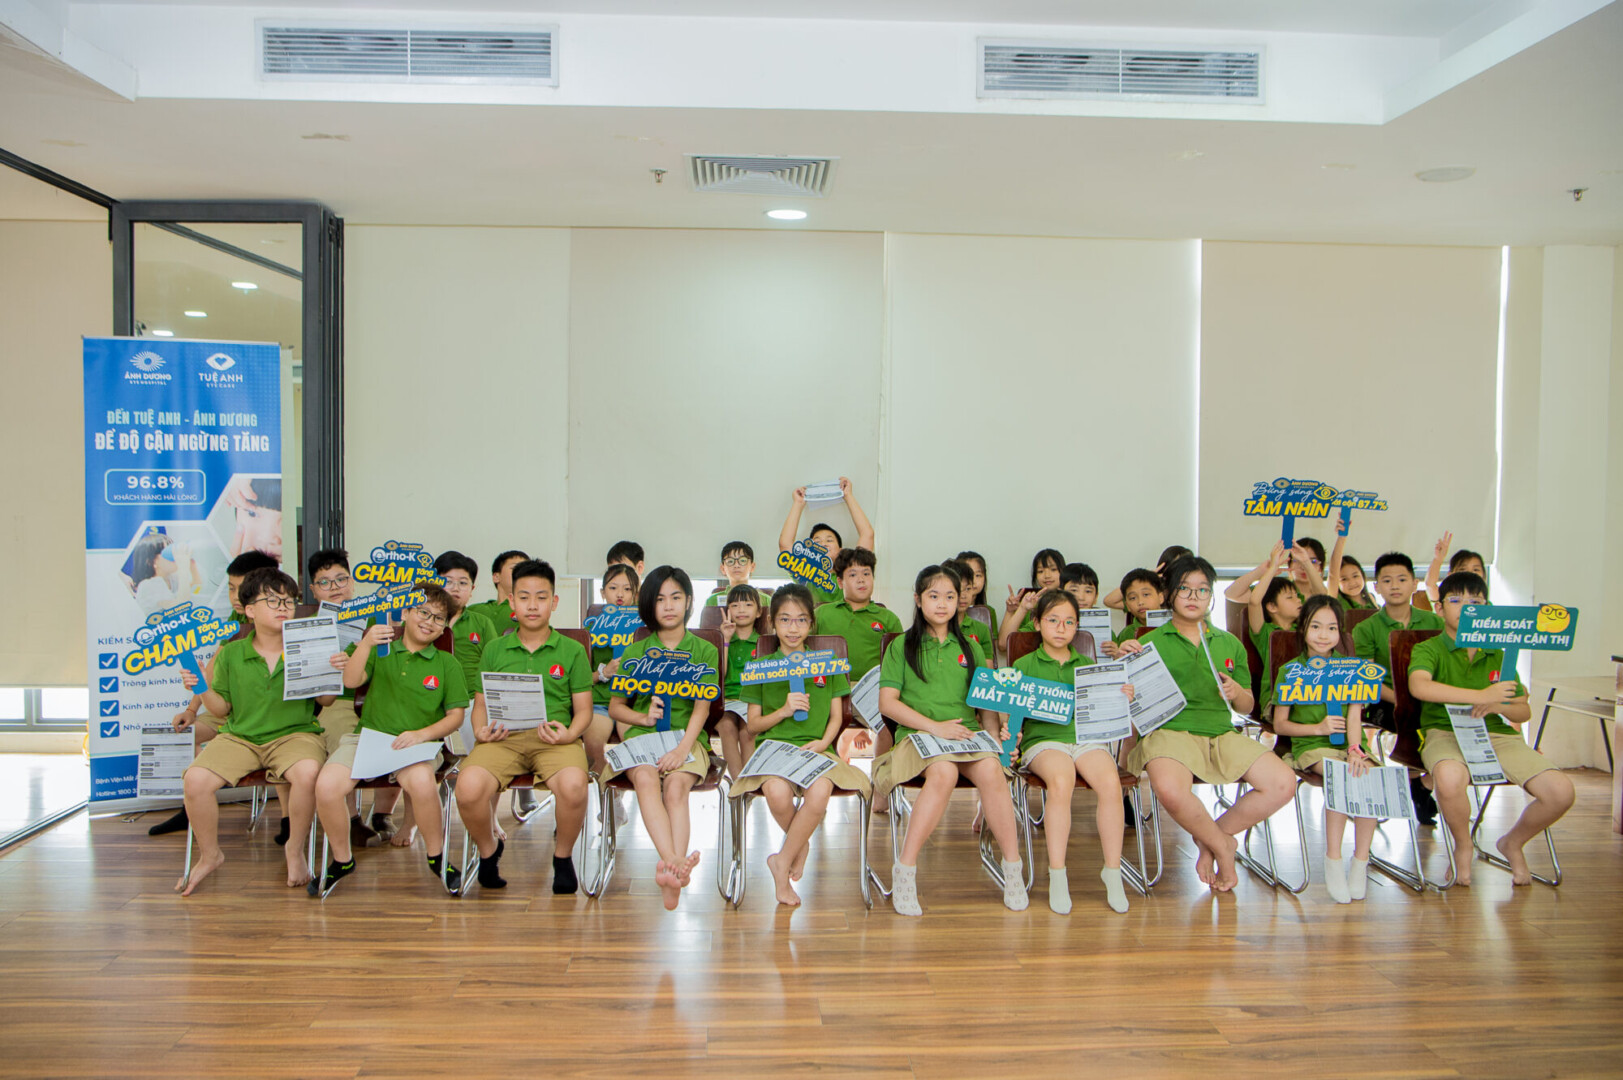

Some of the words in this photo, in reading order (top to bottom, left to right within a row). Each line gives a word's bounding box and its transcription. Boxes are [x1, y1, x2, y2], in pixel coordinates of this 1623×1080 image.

[198, 372, 218, 383] TUỆ
[220, 374, 243, 383] ANH
[107, 408, 130, 424] ĐẾN
[134, 409, 154, 427] TUỆ
[158, 412, 181, 425] ANH
[193, 410, 216, 426] ÁNH
[220, 413, 258, 427] DƯƠNG
[95, 429, 116, 450] ĐỂ
[119, 430, 139, 454] ĐỘ
[144, 430, 174, 454] CẬN
[179, 432, 229, 452] NGỪNG
[233, 432, 270, 452] TĂNG
[127, 476, 184, 489] 96.8%
[141, 493, 162, 501] HÀNG
[163, 493, 176, 501] HÀI
[177, 493, 198, 501] LÒNG
[1289, 488, 1314, 501] sáng
[1358, 500, 1387, 510] 87.7%
[1245, 495, 1282, 515] TẦM
[1284, 499, 1329, 517] NHÌN
[372, 548, 416, 563] Ortho-K
[355, 562, 414, 586] CHẬM
[416, 568, 434, 576] Tăng
[779, 553, 817, 580] CHẬM
[338, 608, 357, 620] Kiểm
[358, 604, 375, 616] soát
[376, 601, 391, 613] cận
[393, 590, 425, 609] 87.7%
[136, 613, 191, 645] Ortho-K
[197, 621, 219, 634] Tăng
[201, 634, 215, 644] ĐỘ
[216, 623, 237, 637] CẬN
[1503, 619, 1534, 629] SOÁT
[1461, 630, 1486, 642] TIẾN
[1524, 633, 1547, 646] CẬN
[1550, 635, 1570, 646] THỊ
[125, 629, 197, 674] CHẬM
[624, 658, 676, 678] Mắt
[670, 663, 716, 680] sáng
[741, 669, 765, 682] Kiểm
[767, 667, 788, 678] soát
[790, 666, 808, 677] cận
[810, 660, 850, 674] 87.7%
[746, 662, 760, 670] ÁNH
[760, 660, 778, 668] SÁNG
[779, 658, 789, 666] ĐỎ
[1286, 663, 1325, 684] Bừng
[1328, 668, 1357, 684] sáng
[612, 677, 652, 695] HỌC
[655, 680, 718, 699] ĐƯỜNG
[1020, 682, 1036, 695] HỆ
[1038, 685, 1074, 700] THỐNG
[1280, 677, 1323, 701] TẦM
[1327, 680, 1378, 701] NHÌN
[972, 686, 1005, 702] MẮT
[1008, 693, 1036, 711] TUỆ
[1038, 699, 1071, 715] ANH
